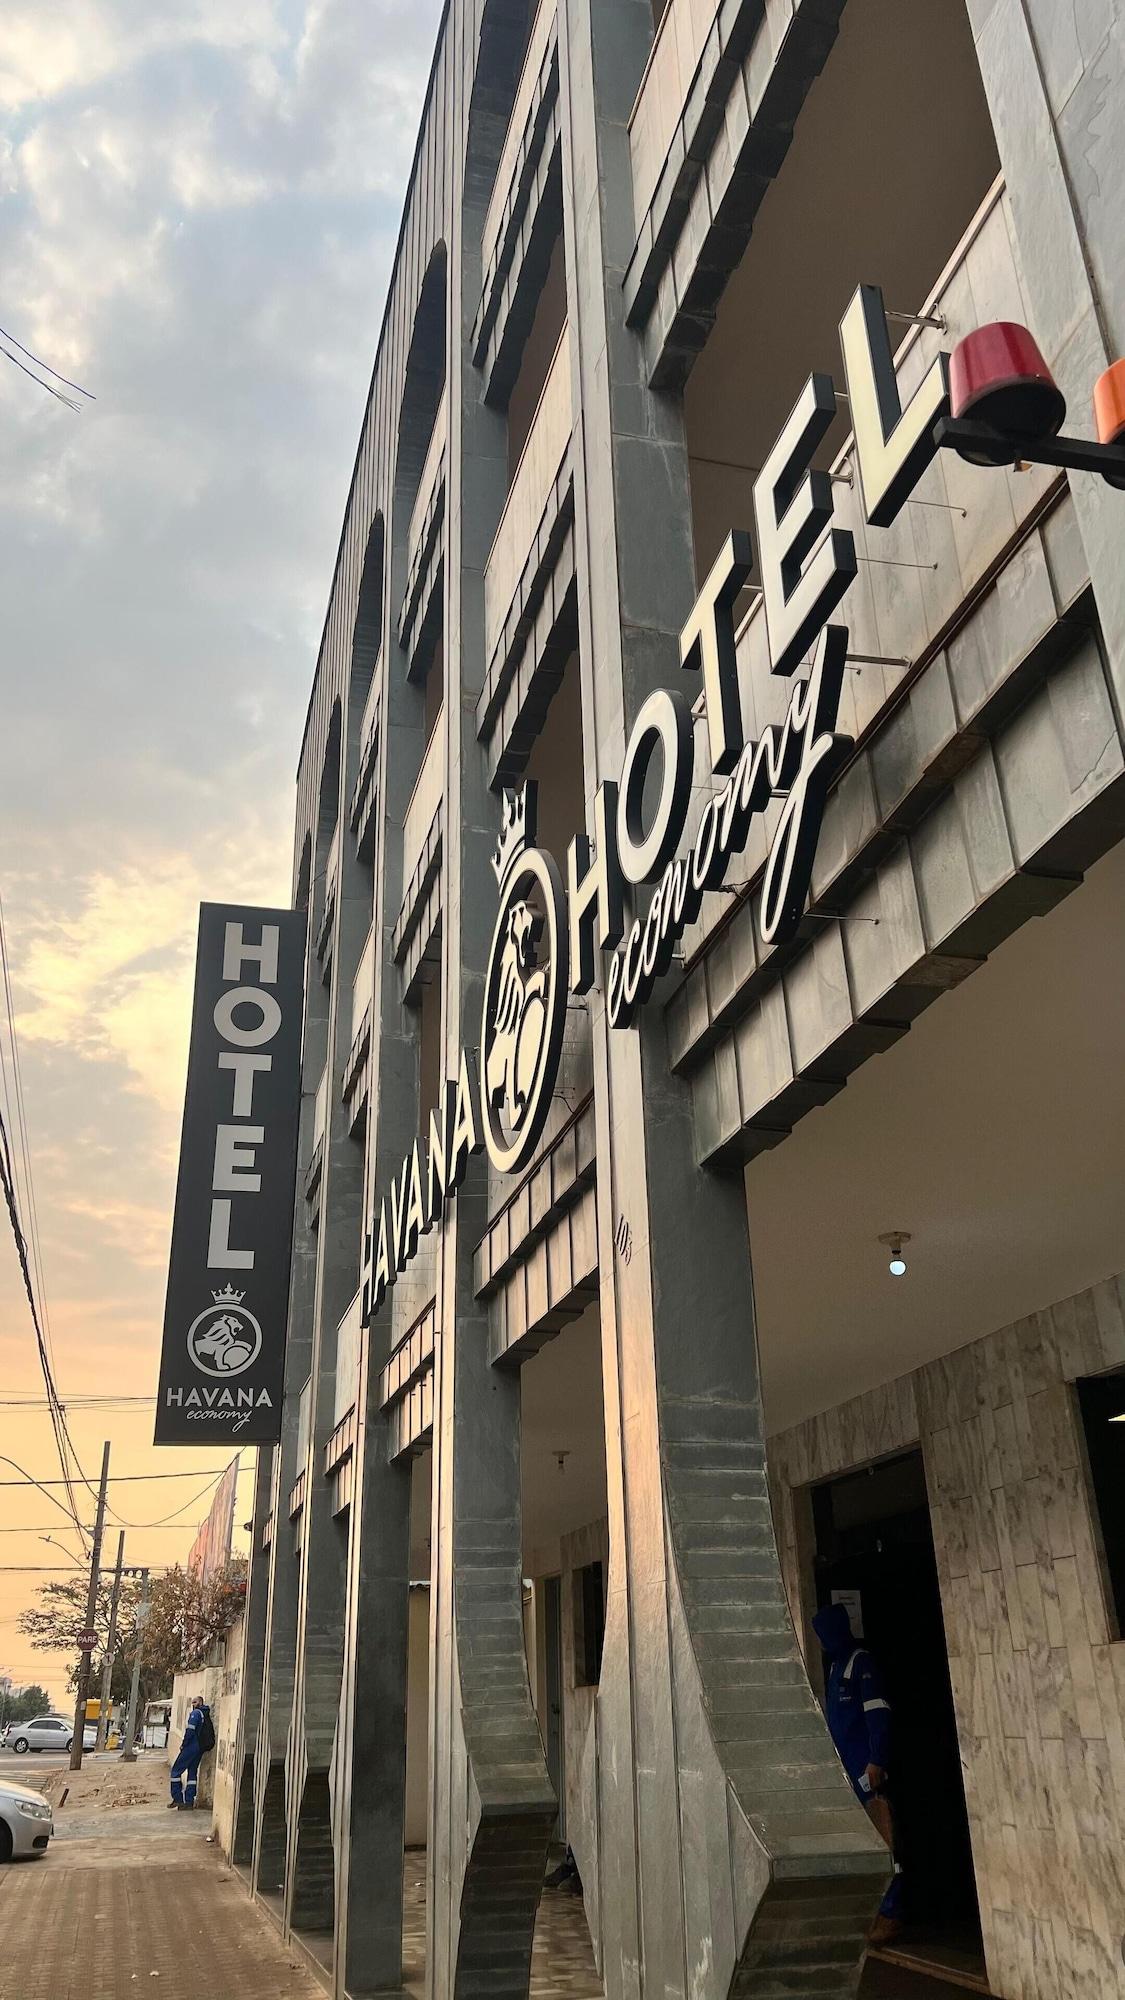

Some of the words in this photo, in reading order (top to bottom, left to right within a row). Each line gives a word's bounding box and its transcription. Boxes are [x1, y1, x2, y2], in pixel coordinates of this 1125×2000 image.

[360, 1047, 486, 1328] HAVANA
[567, 283, 952, 995] HOTEL
[607, 624, 854, 1029] economy
[206, 921, 282, 1270] HOTEL
[166, 1387, 273, 1407] HAVANA
[186, 1409, 253, 1433] economy
[77, 1635, 98, 1644] PARE
